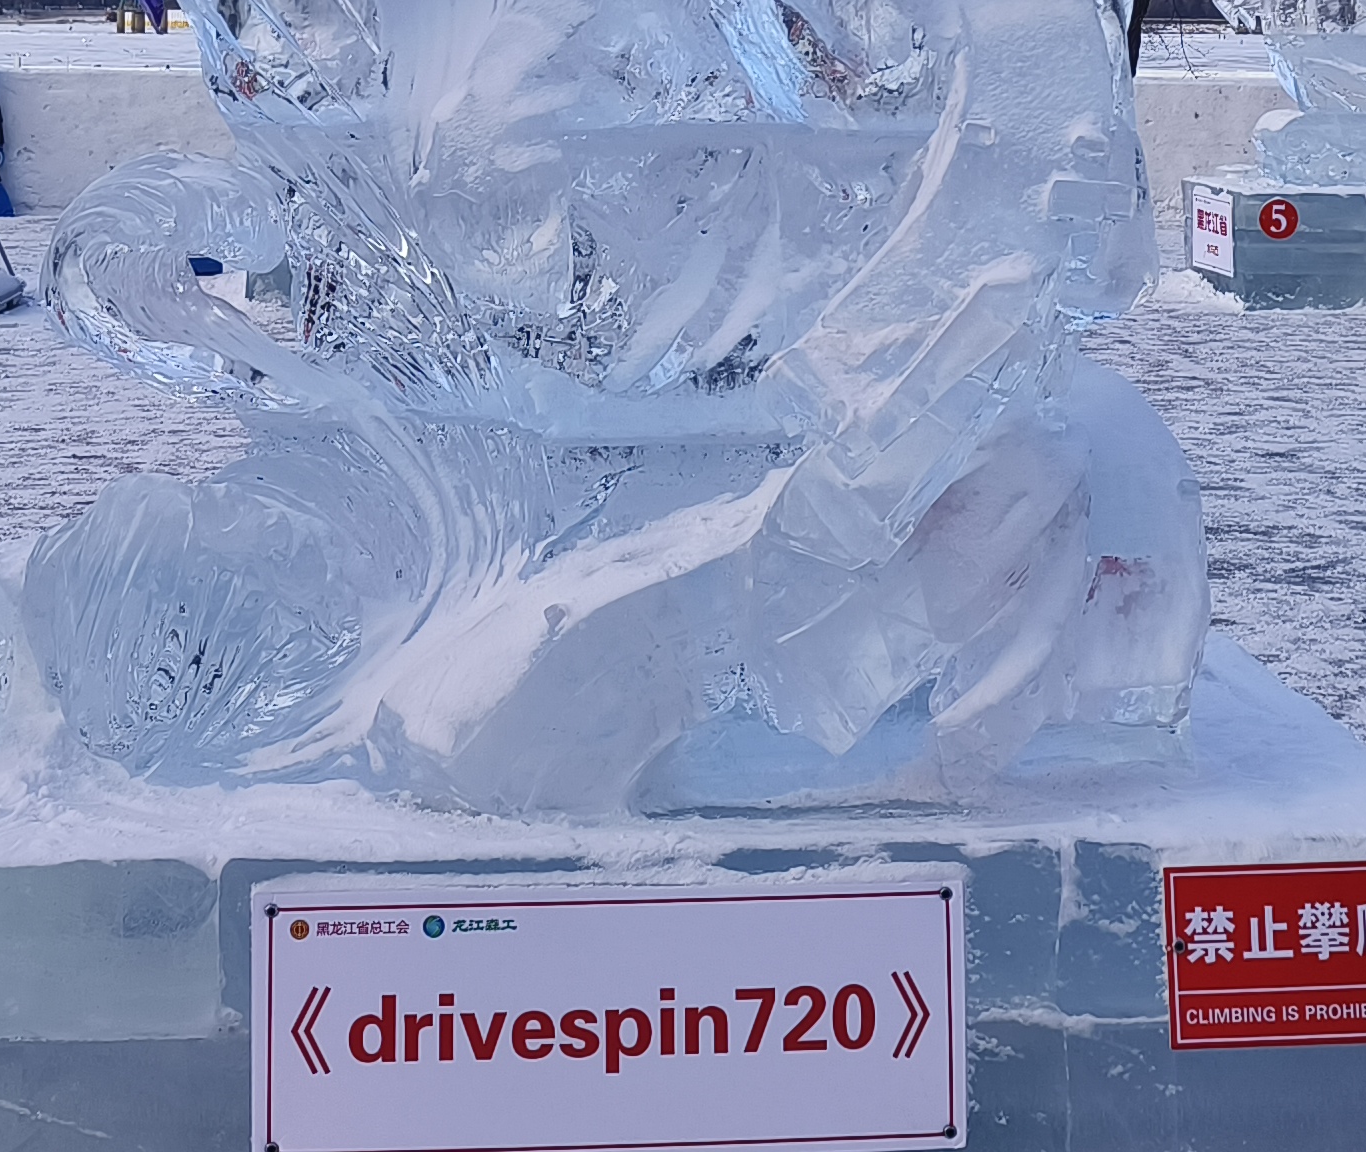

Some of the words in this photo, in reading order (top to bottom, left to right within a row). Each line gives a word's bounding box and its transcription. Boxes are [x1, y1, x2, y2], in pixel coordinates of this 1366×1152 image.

[1270, 204, 1288, 233] 5
[316, 920, 410, 937] 黑龙江省总工会
[452, 918, 518, 933] 龙江森工
[1186, 1006, 1276, 1026] CLIMBING
[1282, 1004, 1300, 1022] IS
